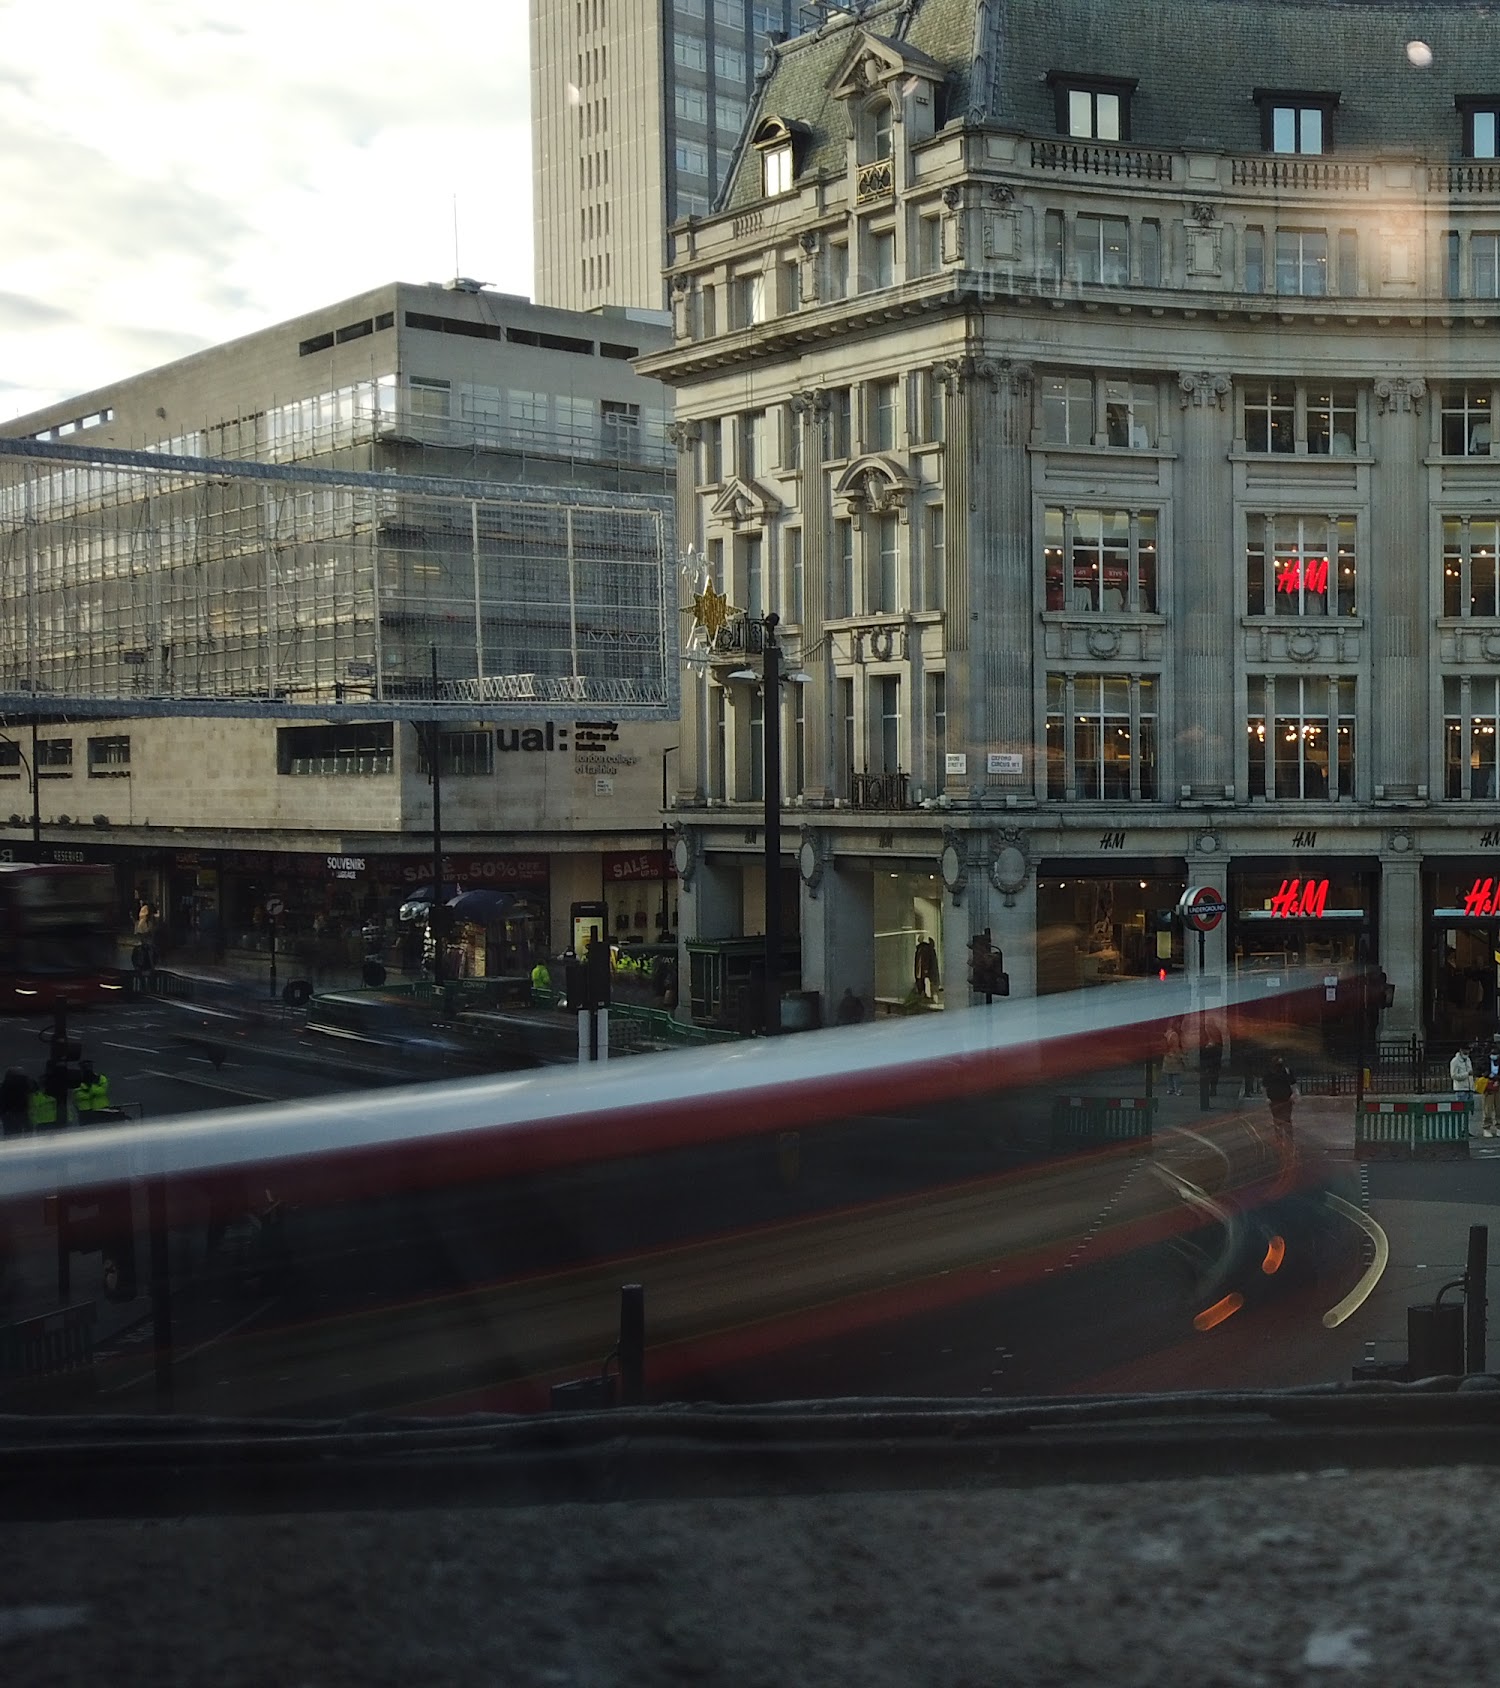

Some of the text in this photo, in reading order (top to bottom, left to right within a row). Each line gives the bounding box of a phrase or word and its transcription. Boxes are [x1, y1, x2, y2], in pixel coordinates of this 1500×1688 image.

[1100, 832, 1125, 849] H&M
[1292, 831, 1317, 848] H&M
[53, 850, 84, 862] RESERVED
[327, 857, 366, 871] SOUVENIRS
[469, 861, 517, 877] 50%
[613, 855, 650, 878] SALE
[1271, 878, 1330, 919] H&M
[1188, 903, 1226, 914] UNDERGROUND
